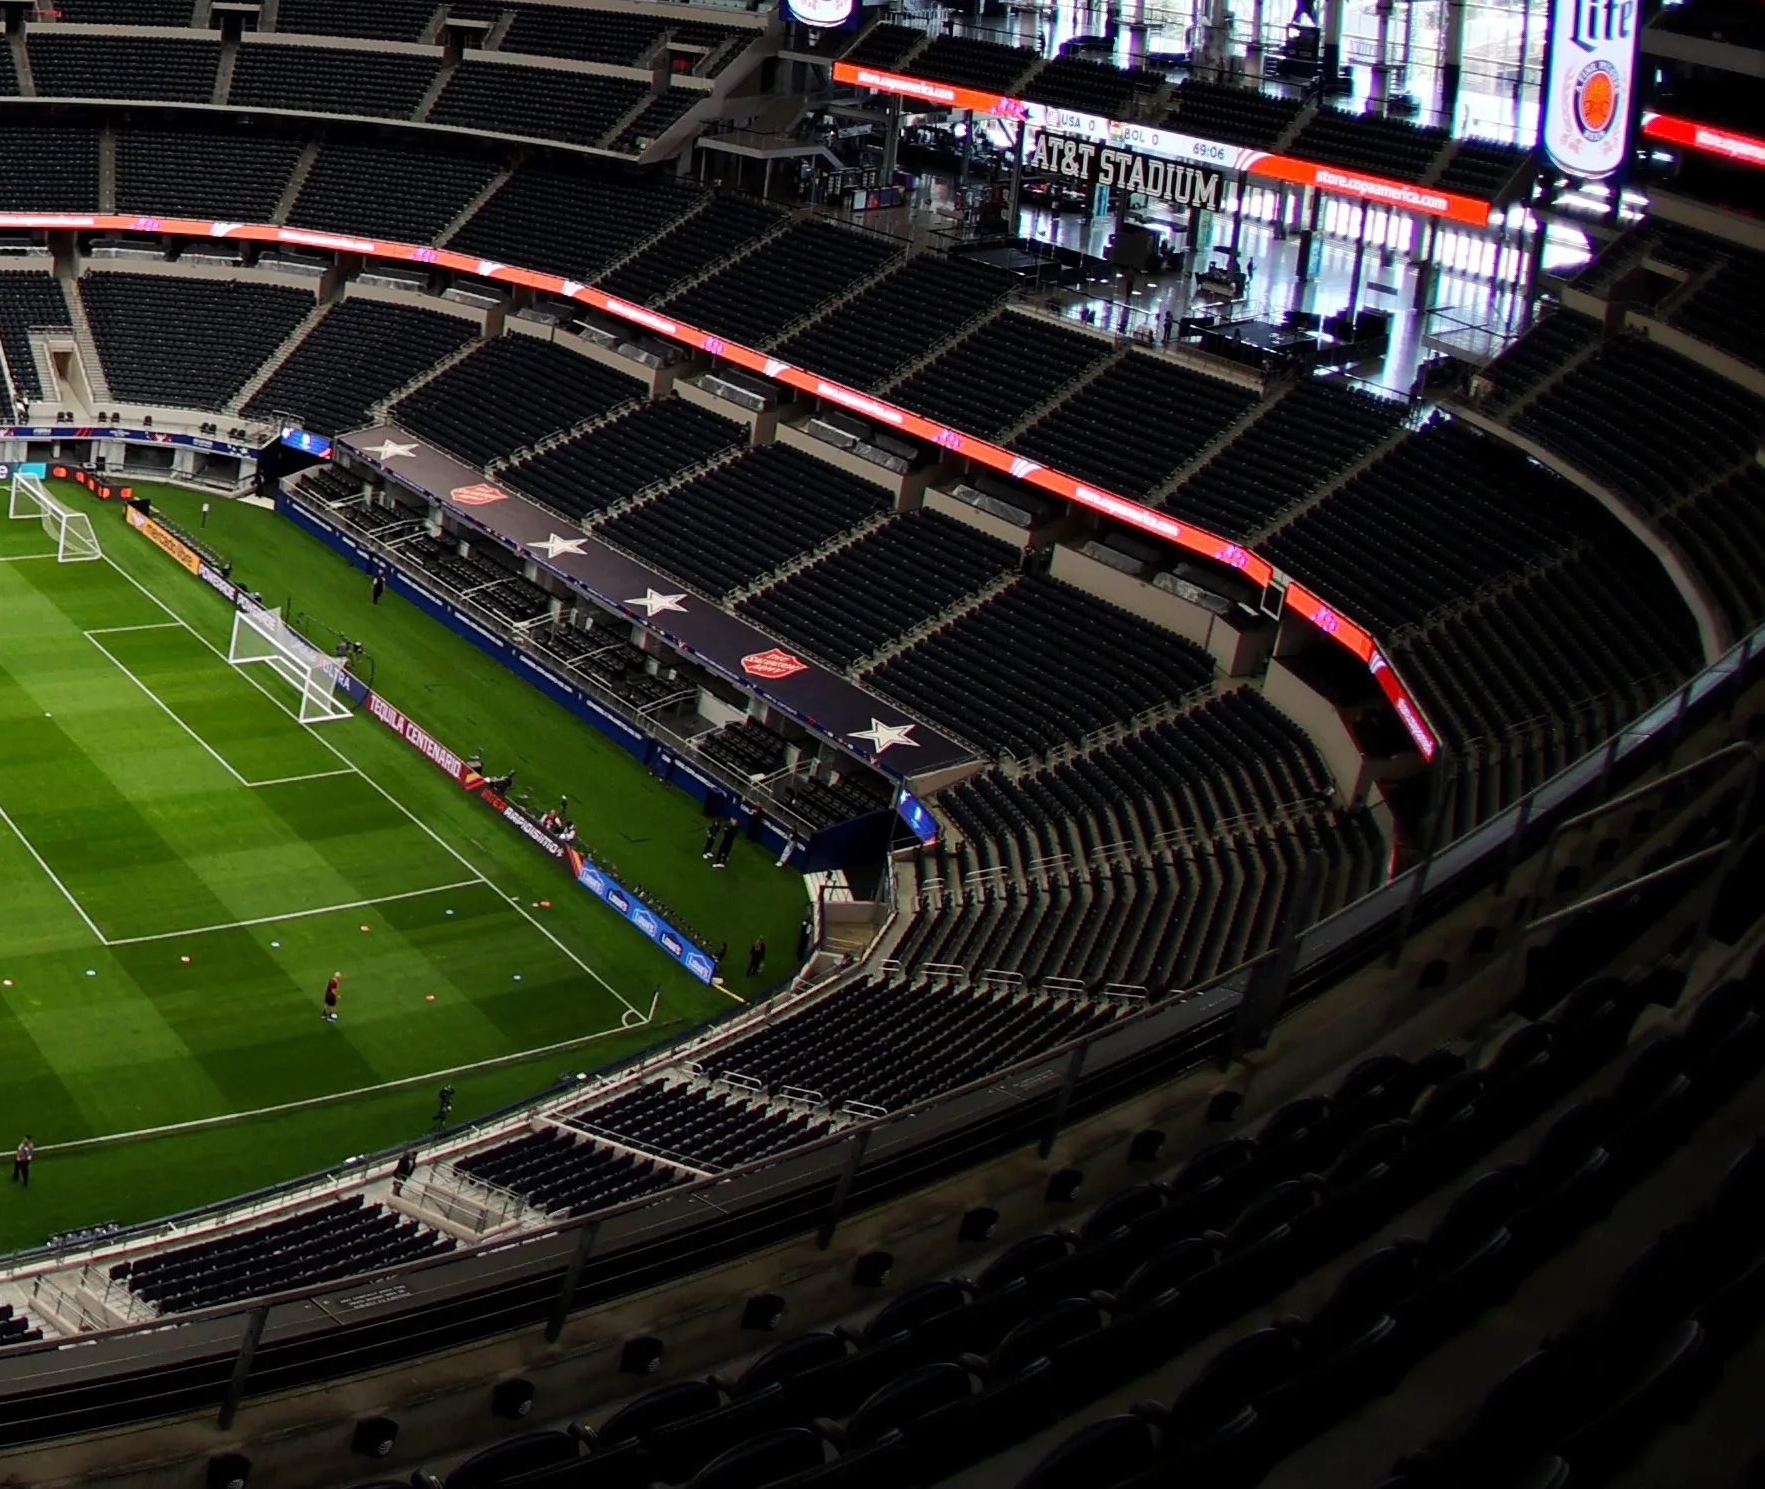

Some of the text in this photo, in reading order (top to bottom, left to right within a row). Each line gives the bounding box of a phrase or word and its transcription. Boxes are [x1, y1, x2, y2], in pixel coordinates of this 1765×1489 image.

[858, 72, 954, 100] store.copaamerica.com
[1061, 113, 1225, 161] USA 0 BOL 0 69:06
[1031, 134, 1220, 211] AT&T STADIUM
[1315, 170, 1447, 211] store.copaamerica.com
[145, 518, 174, 549] mercado
[1076, 487, 1178, 536] store.copaamerica.com
[200, 563, 277, 631] POWERADE POWERADE
[323, 656, 351, 690] ULTRA
[370, 693, 462, 779] TEQUILA CENTENARIO
[503, 806, 560, 856] RAPIDISIMO
